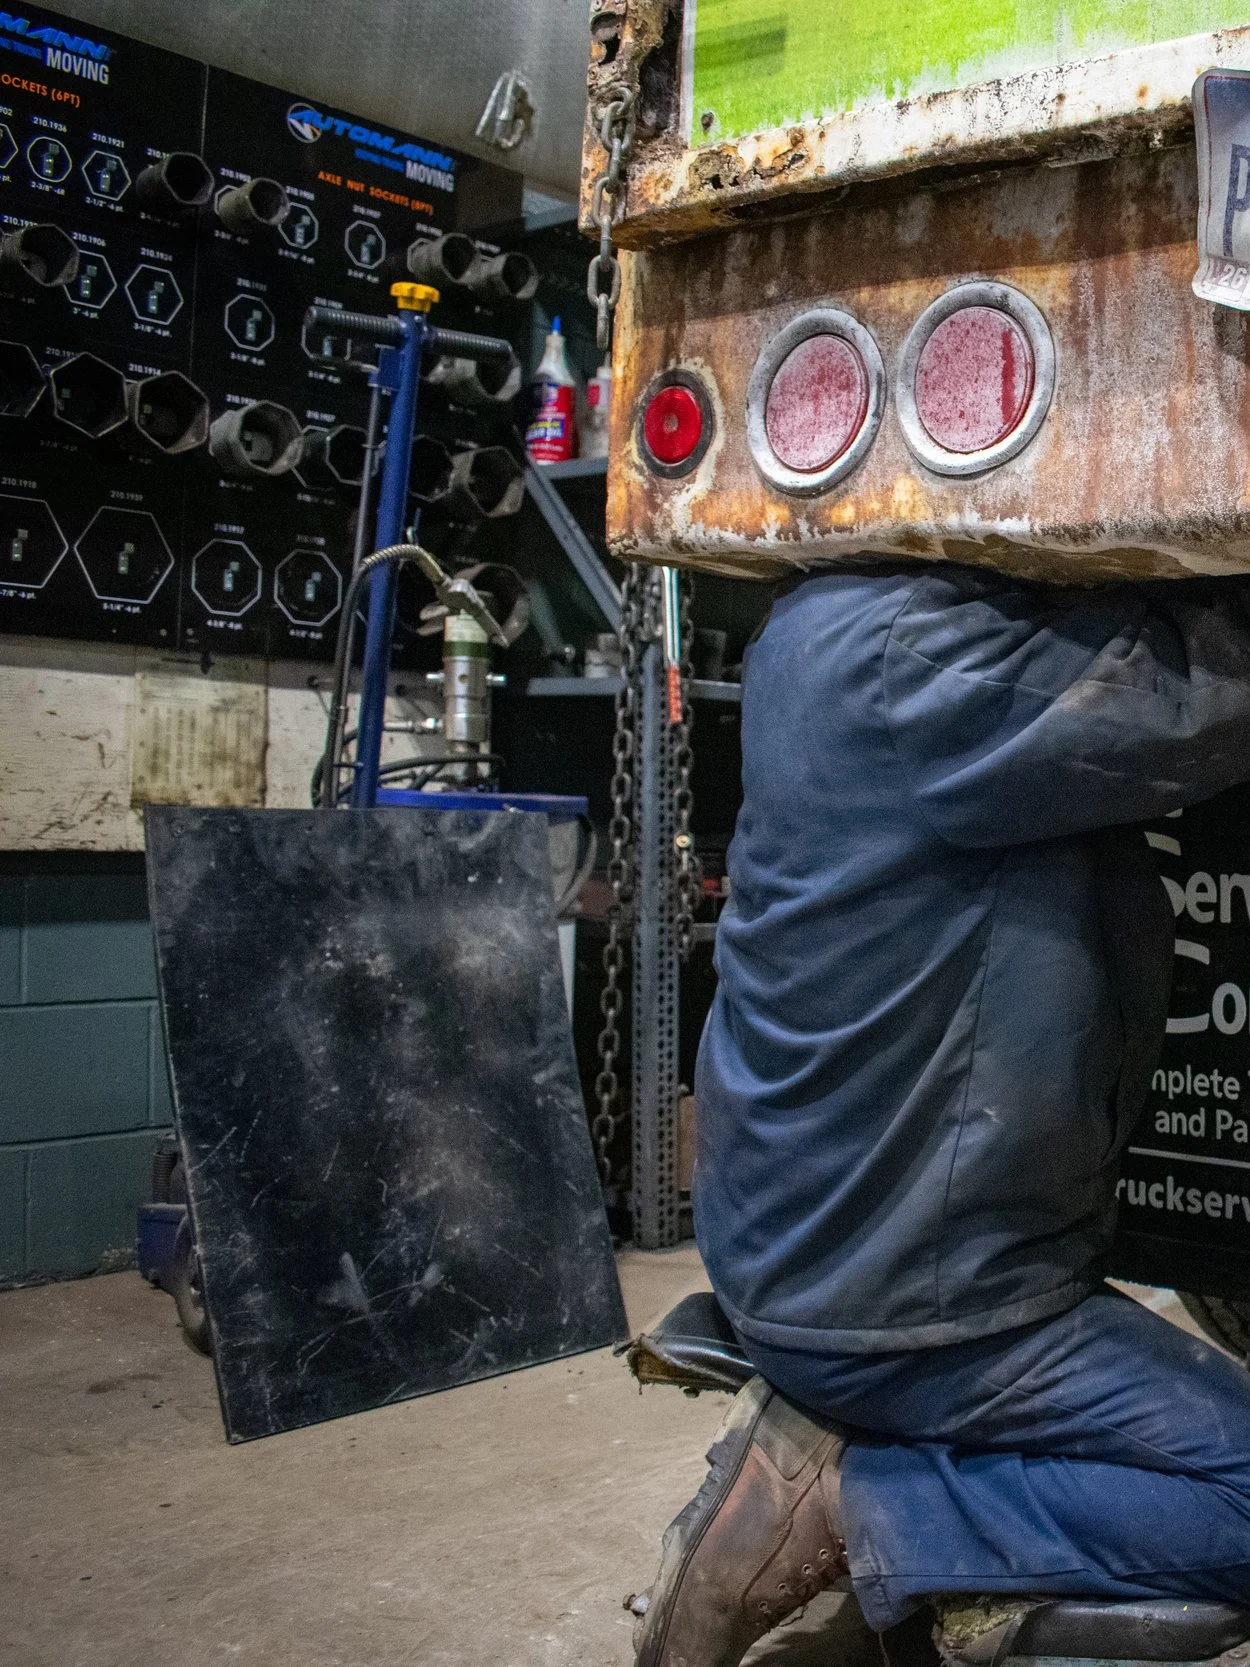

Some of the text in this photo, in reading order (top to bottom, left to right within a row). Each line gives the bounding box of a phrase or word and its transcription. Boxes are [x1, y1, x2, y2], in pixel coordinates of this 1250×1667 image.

[46, 47, 109, 85] MOVING
[51, 88, 81, 108] (6PT)
[288, 108, 455, 171] AUTOMANN
[317, 170, 342, 186] AXLE
[368, 186, 410, 207] SOCKETS
[406, 160, 455, 192] MOVING
[1155, 1107, 1206, 1138] and
